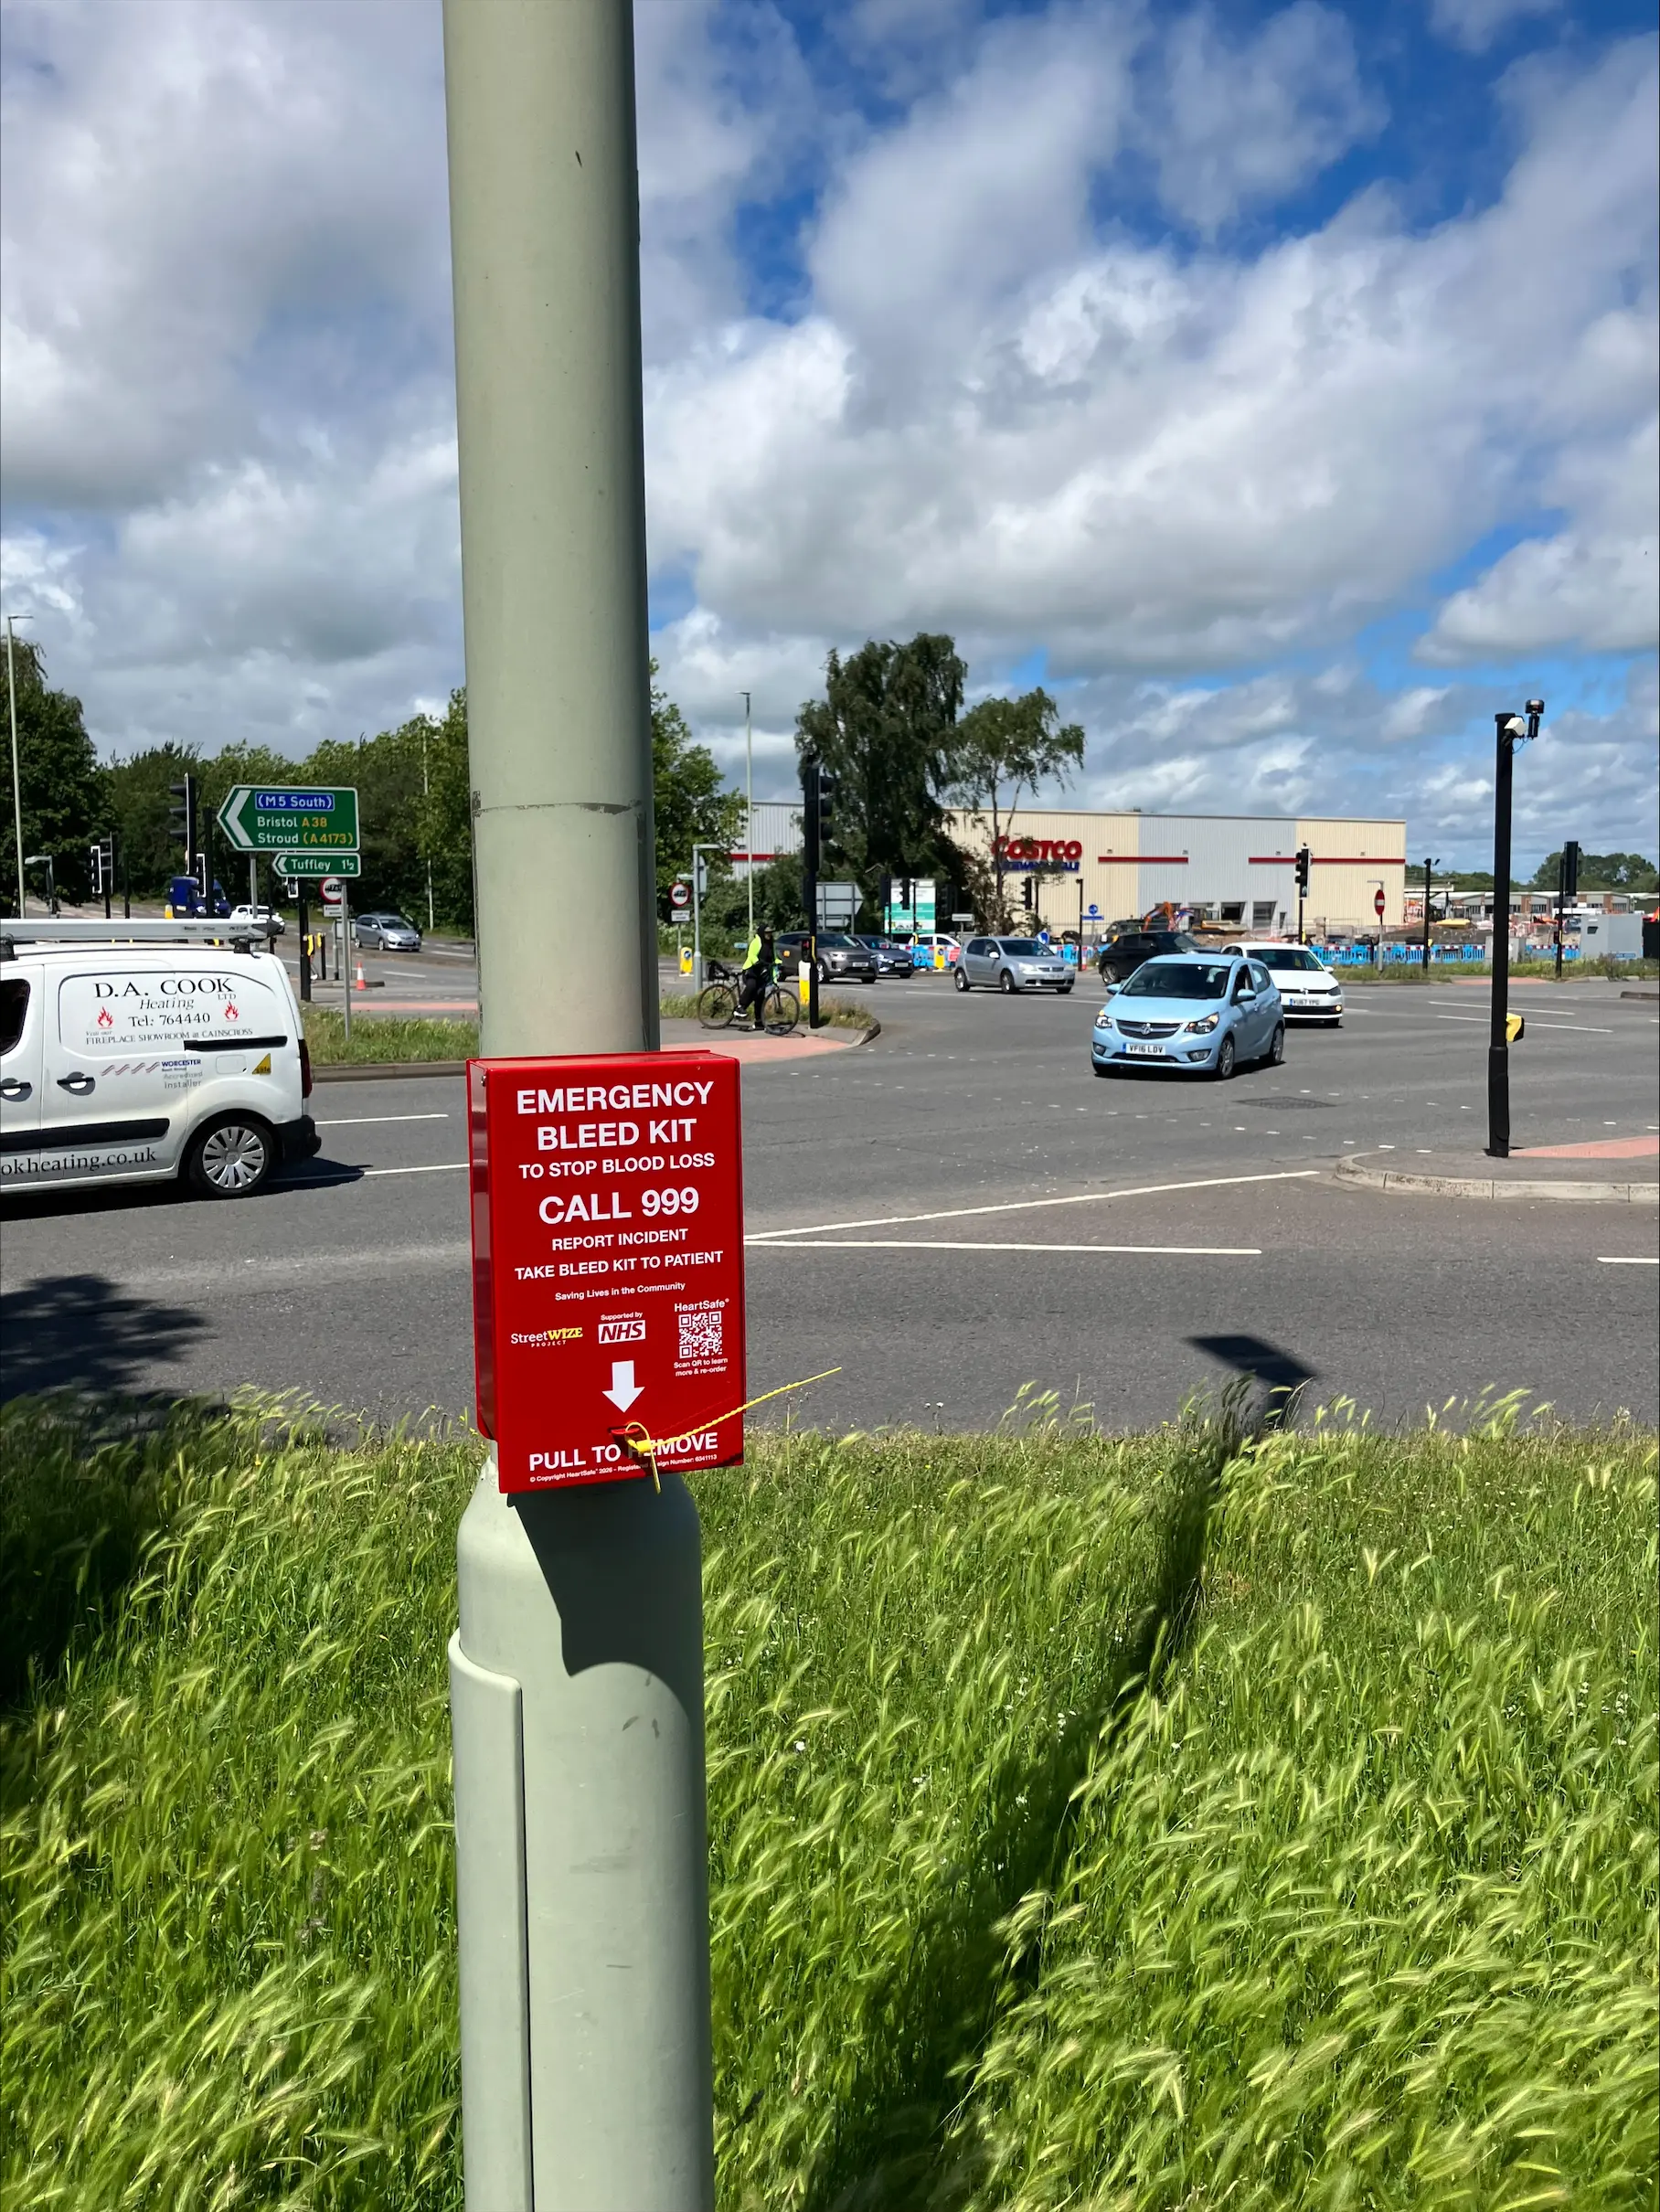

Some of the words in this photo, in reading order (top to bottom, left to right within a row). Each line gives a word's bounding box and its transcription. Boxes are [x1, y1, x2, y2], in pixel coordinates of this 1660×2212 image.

[291, 795, 333, 809] South)
[257, 816, 298, 828] Bristol
[302, 817, 327, 828] A38
[258, 833, 299, 845] Stroud
[303, 833, 354, 845] (A4173)
[291, 859, 331, 872] Tuffley
[93, 982, 149, 998] D.A.
[160, 978, 234, 995] COOK
[140, 997, 195, 1010] Heating
[128, 1015, 154, 1026] Tel:
[158, 1012, 210, 1026] 764440
[86, 1035, 136, 1045] FIREPLACE
[138, 1032, 190, 1042] SHOWROOM
[201, 1028, 253, 1038] CAINSCROSS
[161, 1058, 201, 1068] WORCESTER
[516, 1080, 714, 1114] EMERGENCY
[537, 1122, 639, 1151] BLEED
[649, 1118, 697, 1143] KIT
[0, 1146, 156, 1176] okheating.co.uk
[518, 1163, 544, 1179] TO
[548, 1160, 597, 1178] STOP
[602, 1155, 665, 1175] BLOOD
[670, 1153, 715, 1169] LOSS
[538, 1192, 632, 1225] CALL
[641, 1186, 699, 1218] 999
[551, 1234, 614, 1251] REPORT
[618, 1228, 688, 1246] INCIDENT
[515, 1264, 555, 1281] TAKE
[559, 1260, 609, 1277] BLEED
[613, 1257, 637, 1271] KIT
[641, 1255, 660, 1270] TO
[665, 1250, 724, 1268] PATIENT
[555, 1292, 585, 1301] Saving
[587, 1289, 610, 1298] Lives
[612, 1287, 620, 1296] in
[621, 1286, 635, 1295] the
[637, 1281, 686, 1293] Community
[601, 1312, 634, 1321] Supported
[600, 1322, 644, 1343] NHS
[711, 1356, 729, 1365] learn
[700, 1365, 728, 1374] re-order
[529, 1449, 587, 1472] PULL
[591, 1443, 622, 1463] TO
[537, 1473, 566, 1482] Copyright
